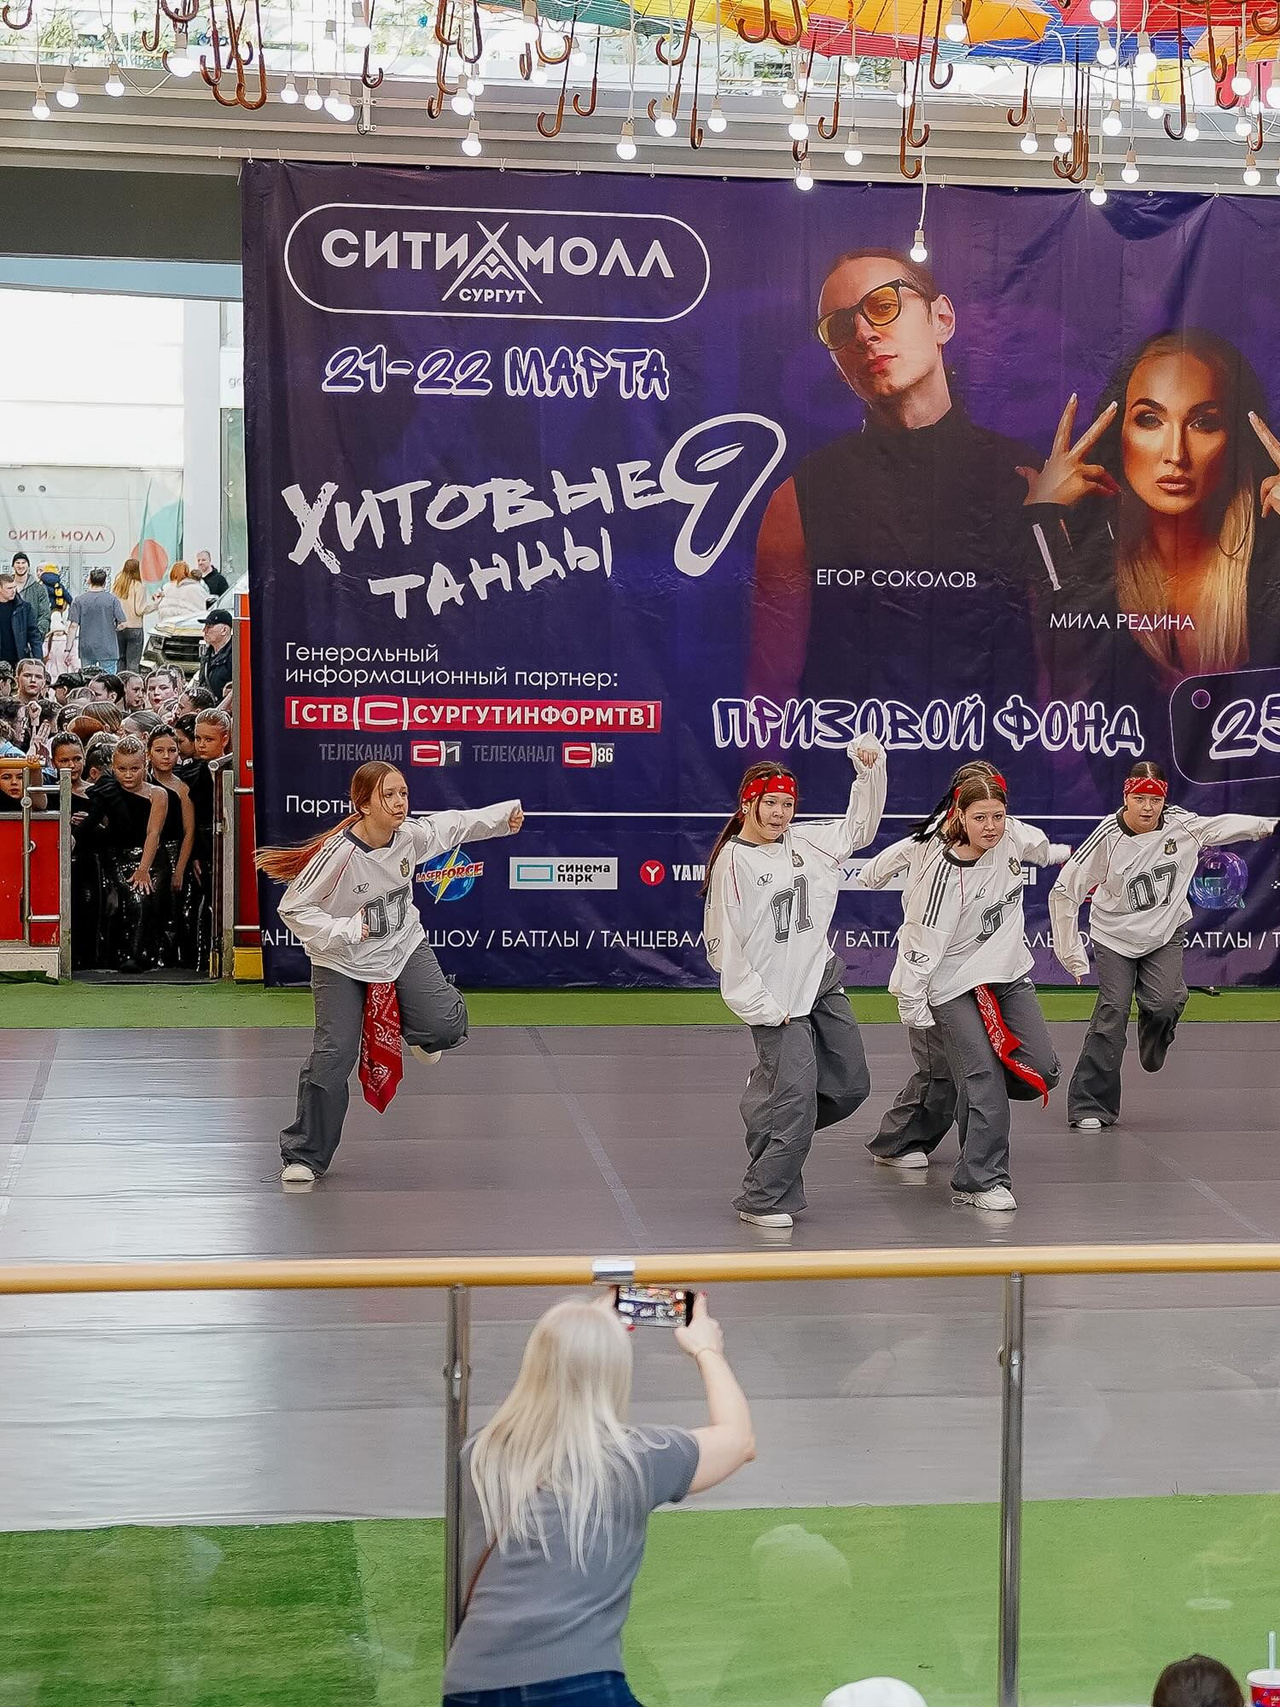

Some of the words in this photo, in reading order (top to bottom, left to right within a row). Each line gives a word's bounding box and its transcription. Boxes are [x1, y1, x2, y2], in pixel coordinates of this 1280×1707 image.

[322, 229, 468, 270] СИТИ
[517, 236, 675, 278] МОЛЛ
[459, 288, 527, 304] СУРГУТ
[322, 344, 493, 396] 21-22
[505, 346, 670, 401] МАРТА
[281, 461, 670, 575] ХИТОВЫЕ
[368, 526, 613, 619] ТАНЦЫ
[816, 569, 865, 587] ЕГОР
[871, 571, 977, 589] СОКОЛОВ
[1049, 613, 1110, 630] МИЛА
[1116, 613, 1195, 632] РЕДИНА
[285, 642, 440, 664] Генеральный
[285, 666, 508, 688] информационный
[514, 671, 619, 690] партнер:
[712, 695, 985, 750] ПРИЗОВОЙ
[993, 695, 1145, 757] ФОНД
[319, 743, 403, 761] ТЕЛЕКАНАЛ
[472, 745, 555, 763] ТЕЛЕКАНАЛ
[286, 795, 353, 816] Партн
[416, 861, 485, 883] LASERFORCE
[557, 862, 611, 873] синема
[557, 873, 593, 886] парк
[1126, 861, 1179, 913] 07
[364, 885, 411, 939] 07
[426, 930, 479, 947] ШОУ
[502, 930, 579, 948] БАТТЛЫ
